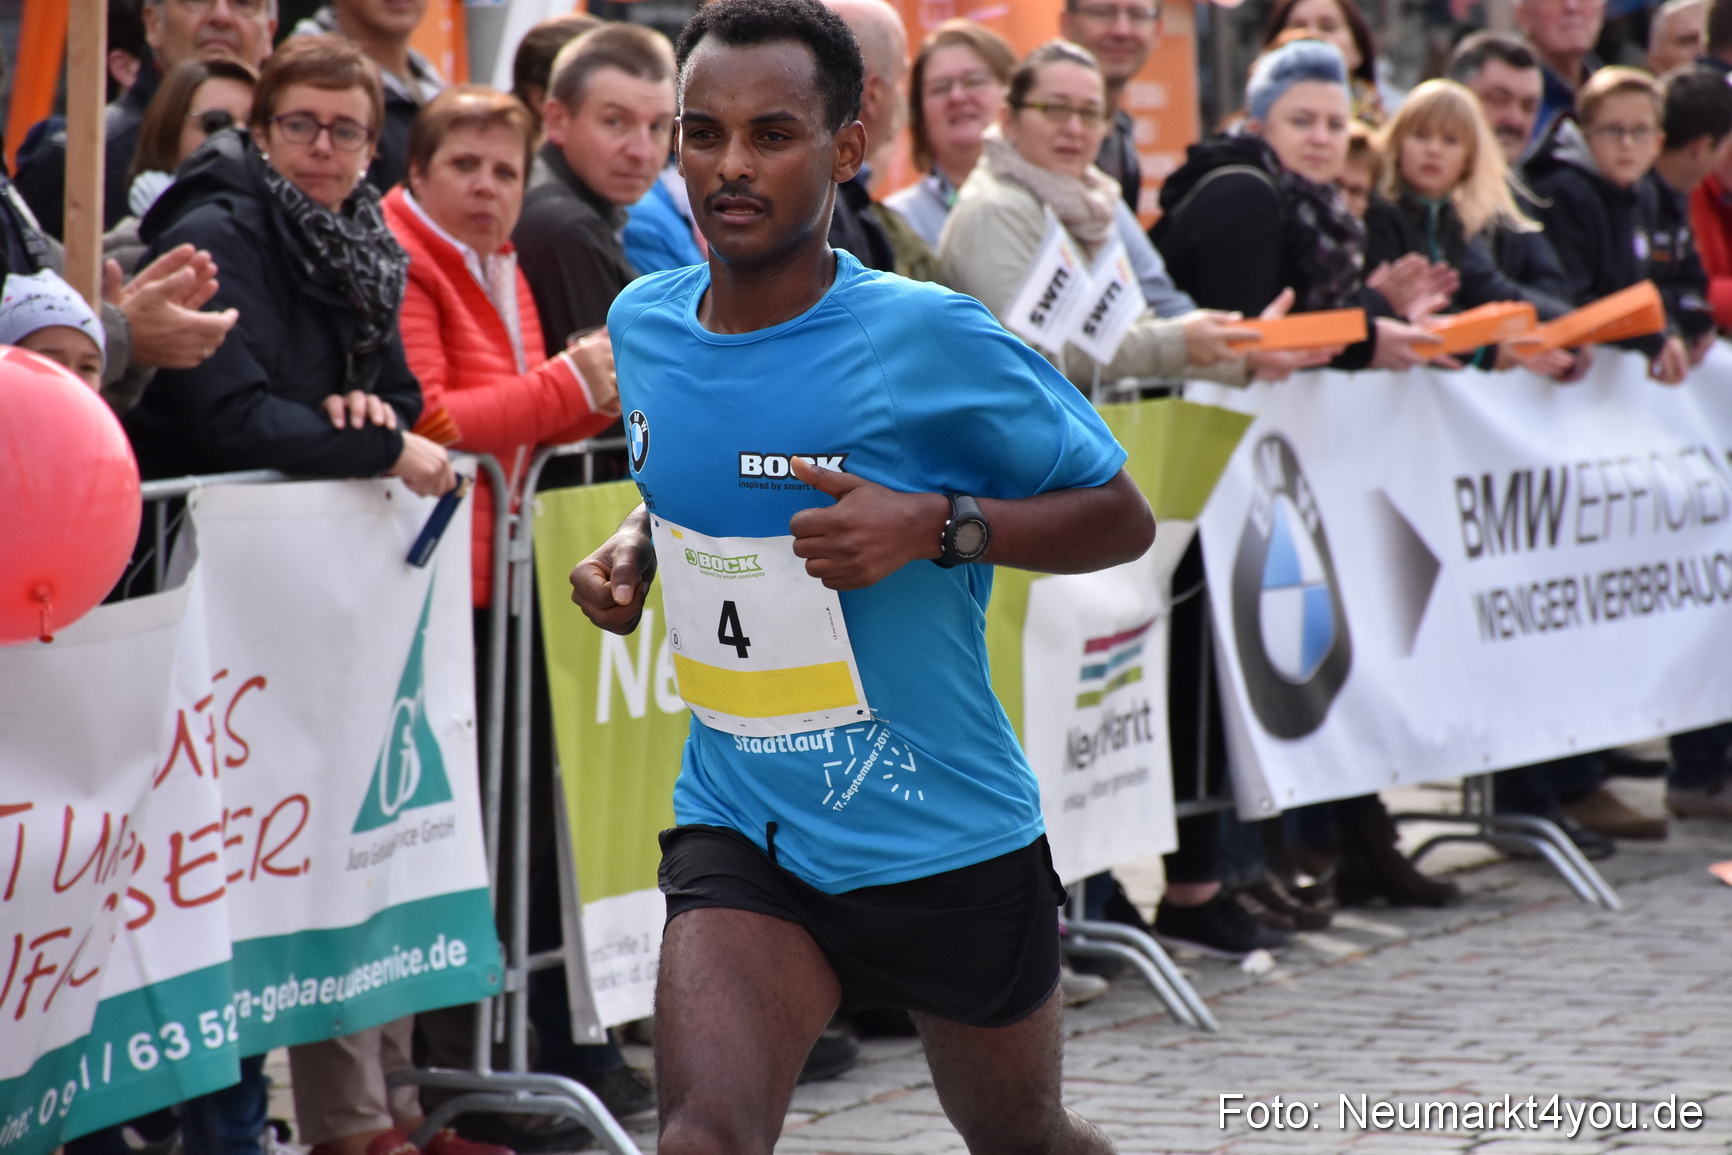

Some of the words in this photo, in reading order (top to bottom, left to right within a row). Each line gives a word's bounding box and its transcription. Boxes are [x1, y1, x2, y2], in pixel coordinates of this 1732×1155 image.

[1029, 268, 1069, 329] swn
[1082, 281, 1122, 341] swn
[739, 479, 769, 491] inspired
[772, 481, 781, 491] by
[1455, 465, 1568, 560] BMW
[698, 553, 763, 573] BOCK
[738, 571, 765, 579] concepts
[674, 633, 679, 645] D
[717, 600, 751, 659] 4
[733, 728, 835, 754] Stadtlauf
[832, 799, 847, 812] 17.
[841, 750, 878, 802] September
[874, 728, 892, 752] 2017
[421, 816, 455, 843] GmbH
[128, 1021, 191, 1071] 63
